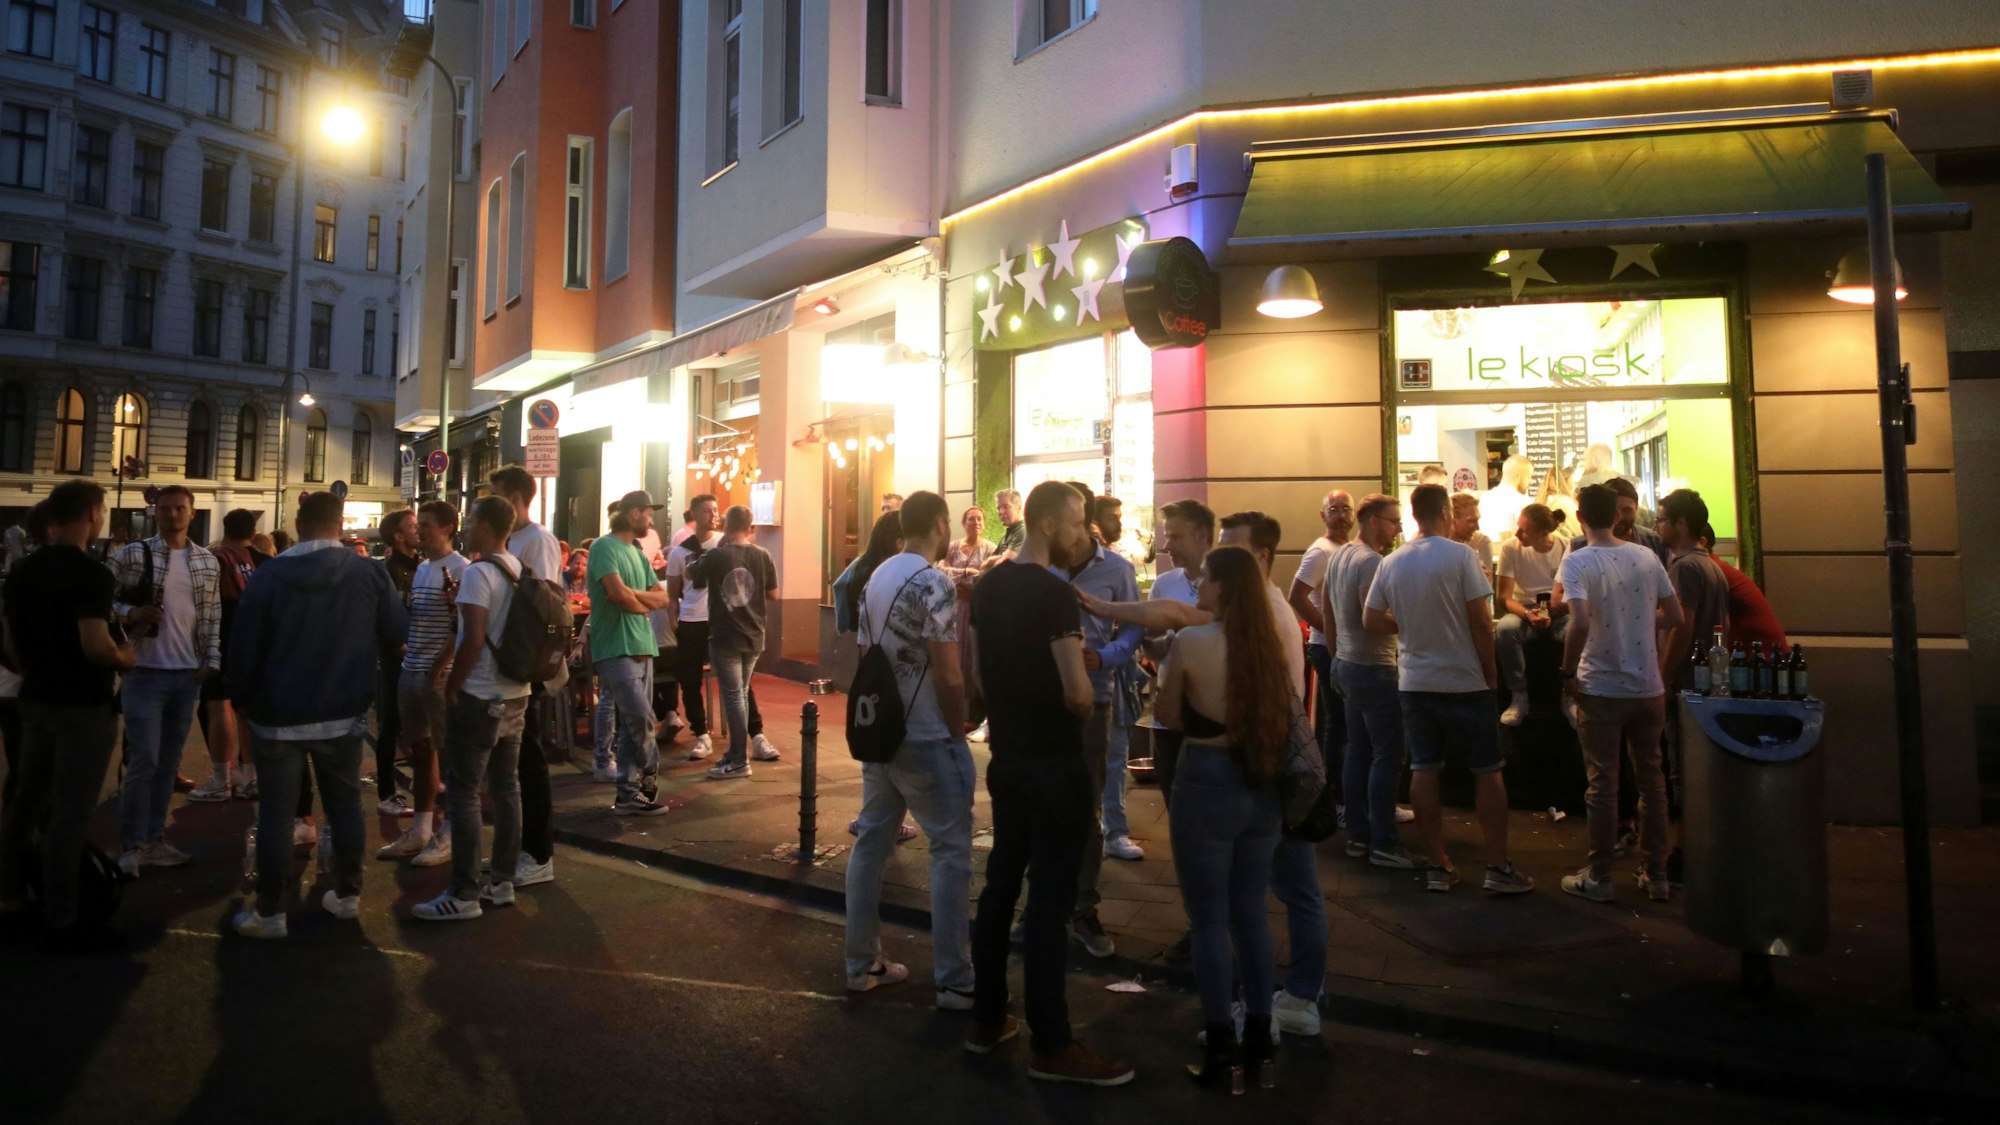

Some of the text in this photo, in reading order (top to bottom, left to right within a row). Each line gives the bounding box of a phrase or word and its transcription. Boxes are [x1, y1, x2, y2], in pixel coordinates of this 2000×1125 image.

[1164, 311, 1206, 336] Coffee
[1468, 342, 1649, 380] le kiosk
